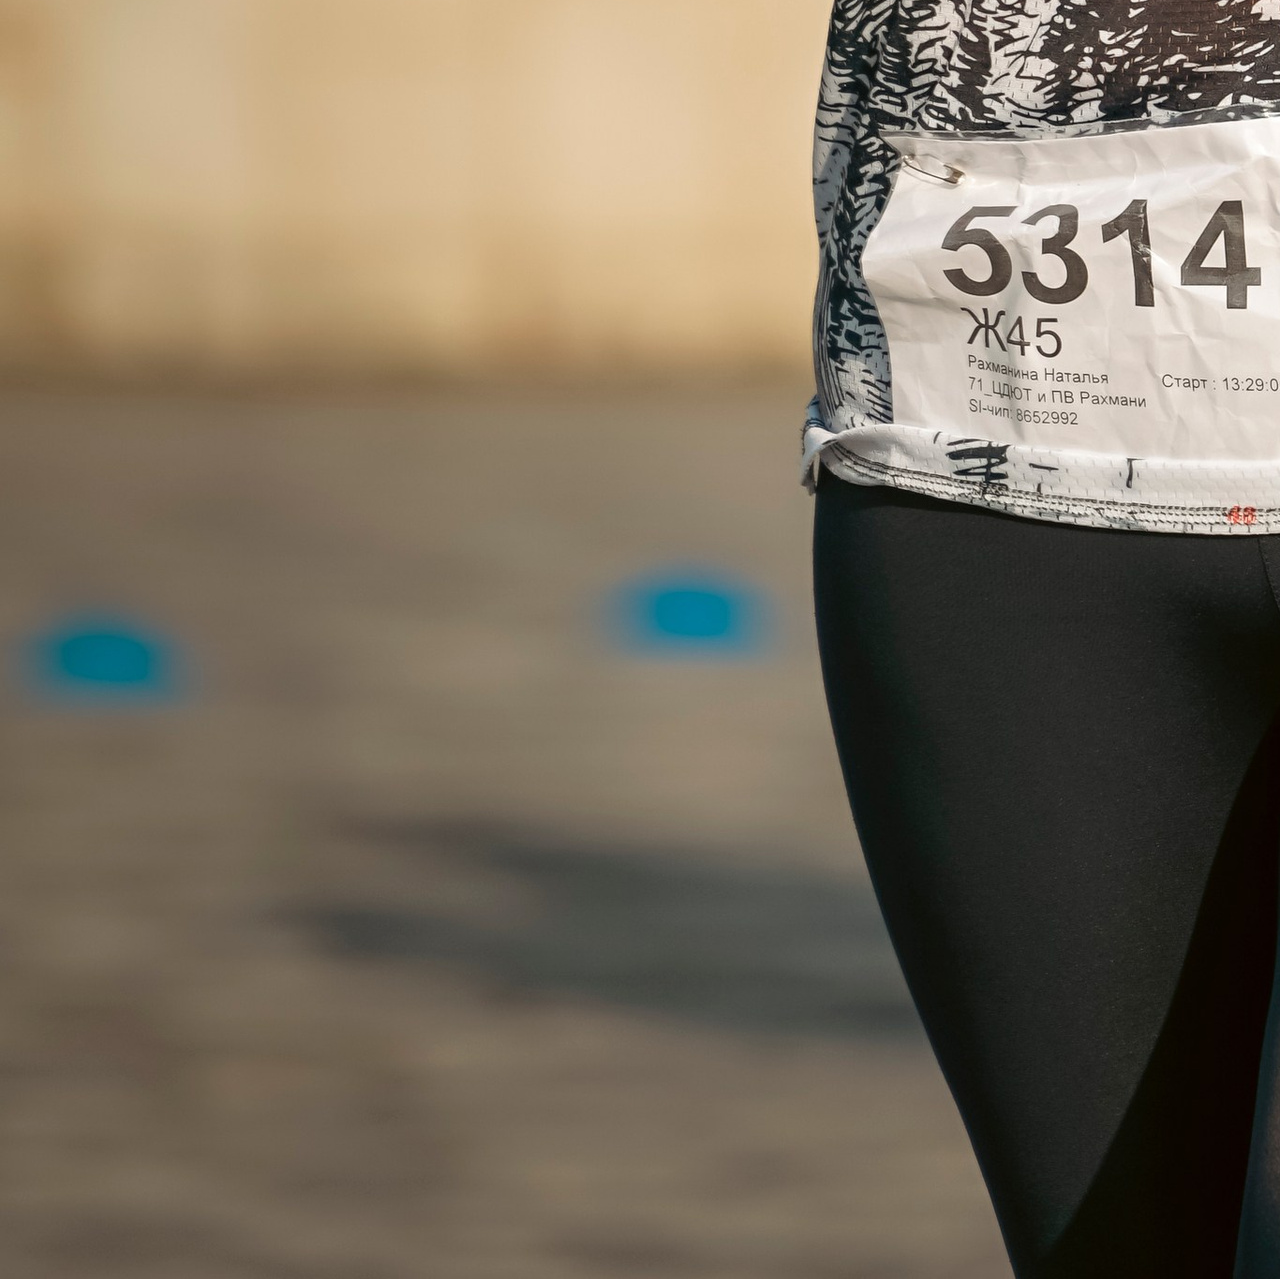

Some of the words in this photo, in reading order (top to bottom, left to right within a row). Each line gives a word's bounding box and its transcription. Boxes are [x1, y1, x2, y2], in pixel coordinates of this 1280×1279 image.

[941, 198, 1262, 310] 5314
[960, 307, 1063, 358] Ж45
[968, 354, 1038, 381] Рахманина
[1044, 368, 1109, 384] Наталья
[1161, 374, 1207, 391] Старт
[968, 376, 1032, 401] 71_ЦДЮТ
[1037, 392, 1046, 402] и
[1052, 391, 1074, 404] ПВ
[1080, 392, 1147, 408] Рахмани
[969, 398, 1013, 419] SI-чип:
[1016, 409, 1079, 425] 8652992
